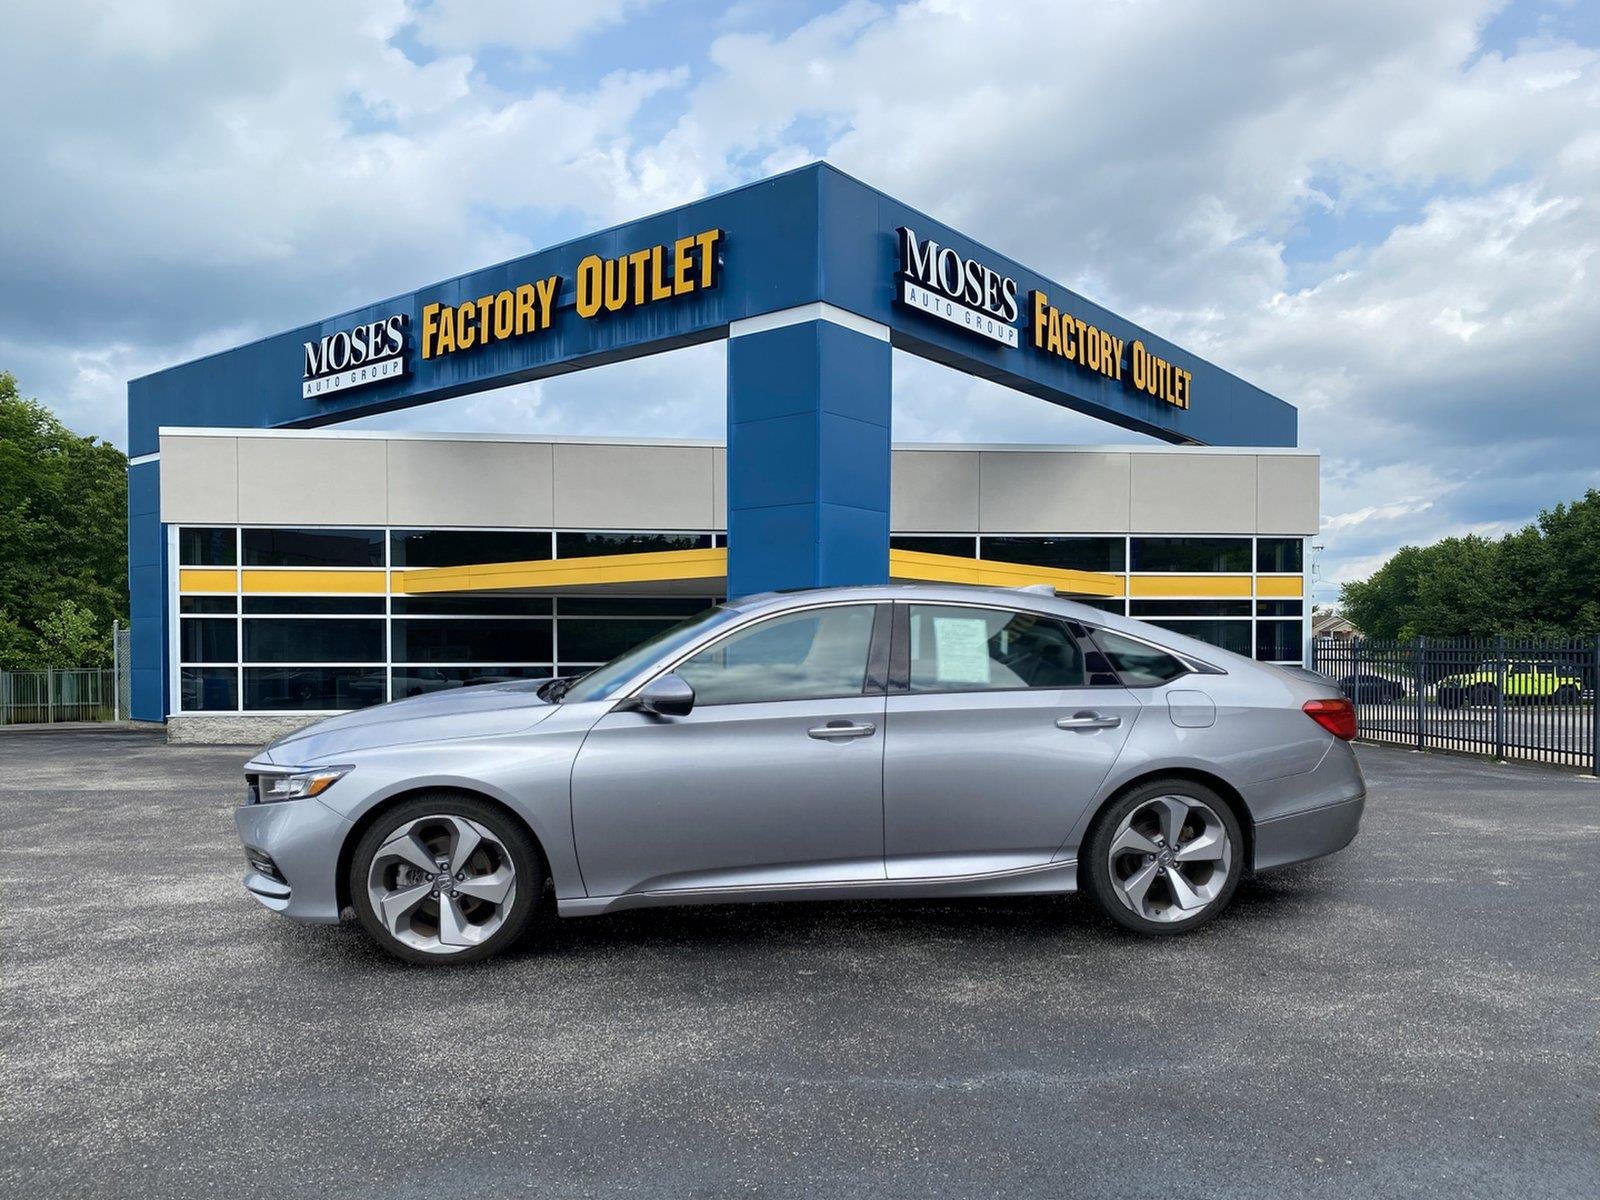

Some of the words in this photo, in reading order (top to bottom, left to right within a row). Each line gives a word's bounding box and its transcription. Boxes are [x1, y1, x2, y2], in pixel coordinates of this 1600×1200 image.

[422, 276, 559, 359] FACTORY
[576, 229, 719, 319] OUTLET
[904, 227, 1019, 323] MOSES
[909, 287, 953, 317] AUTO
[965, 311, 1015, 341] GROUP
[303, 314, 403, 378] MOSES
[306, 376, 341, 394] AUTO
[350, 361, 399, 383] GROUP
[1034, 290, 1124, 380] FACTORY
[1132, 340, 1192, 410] OUTLET
